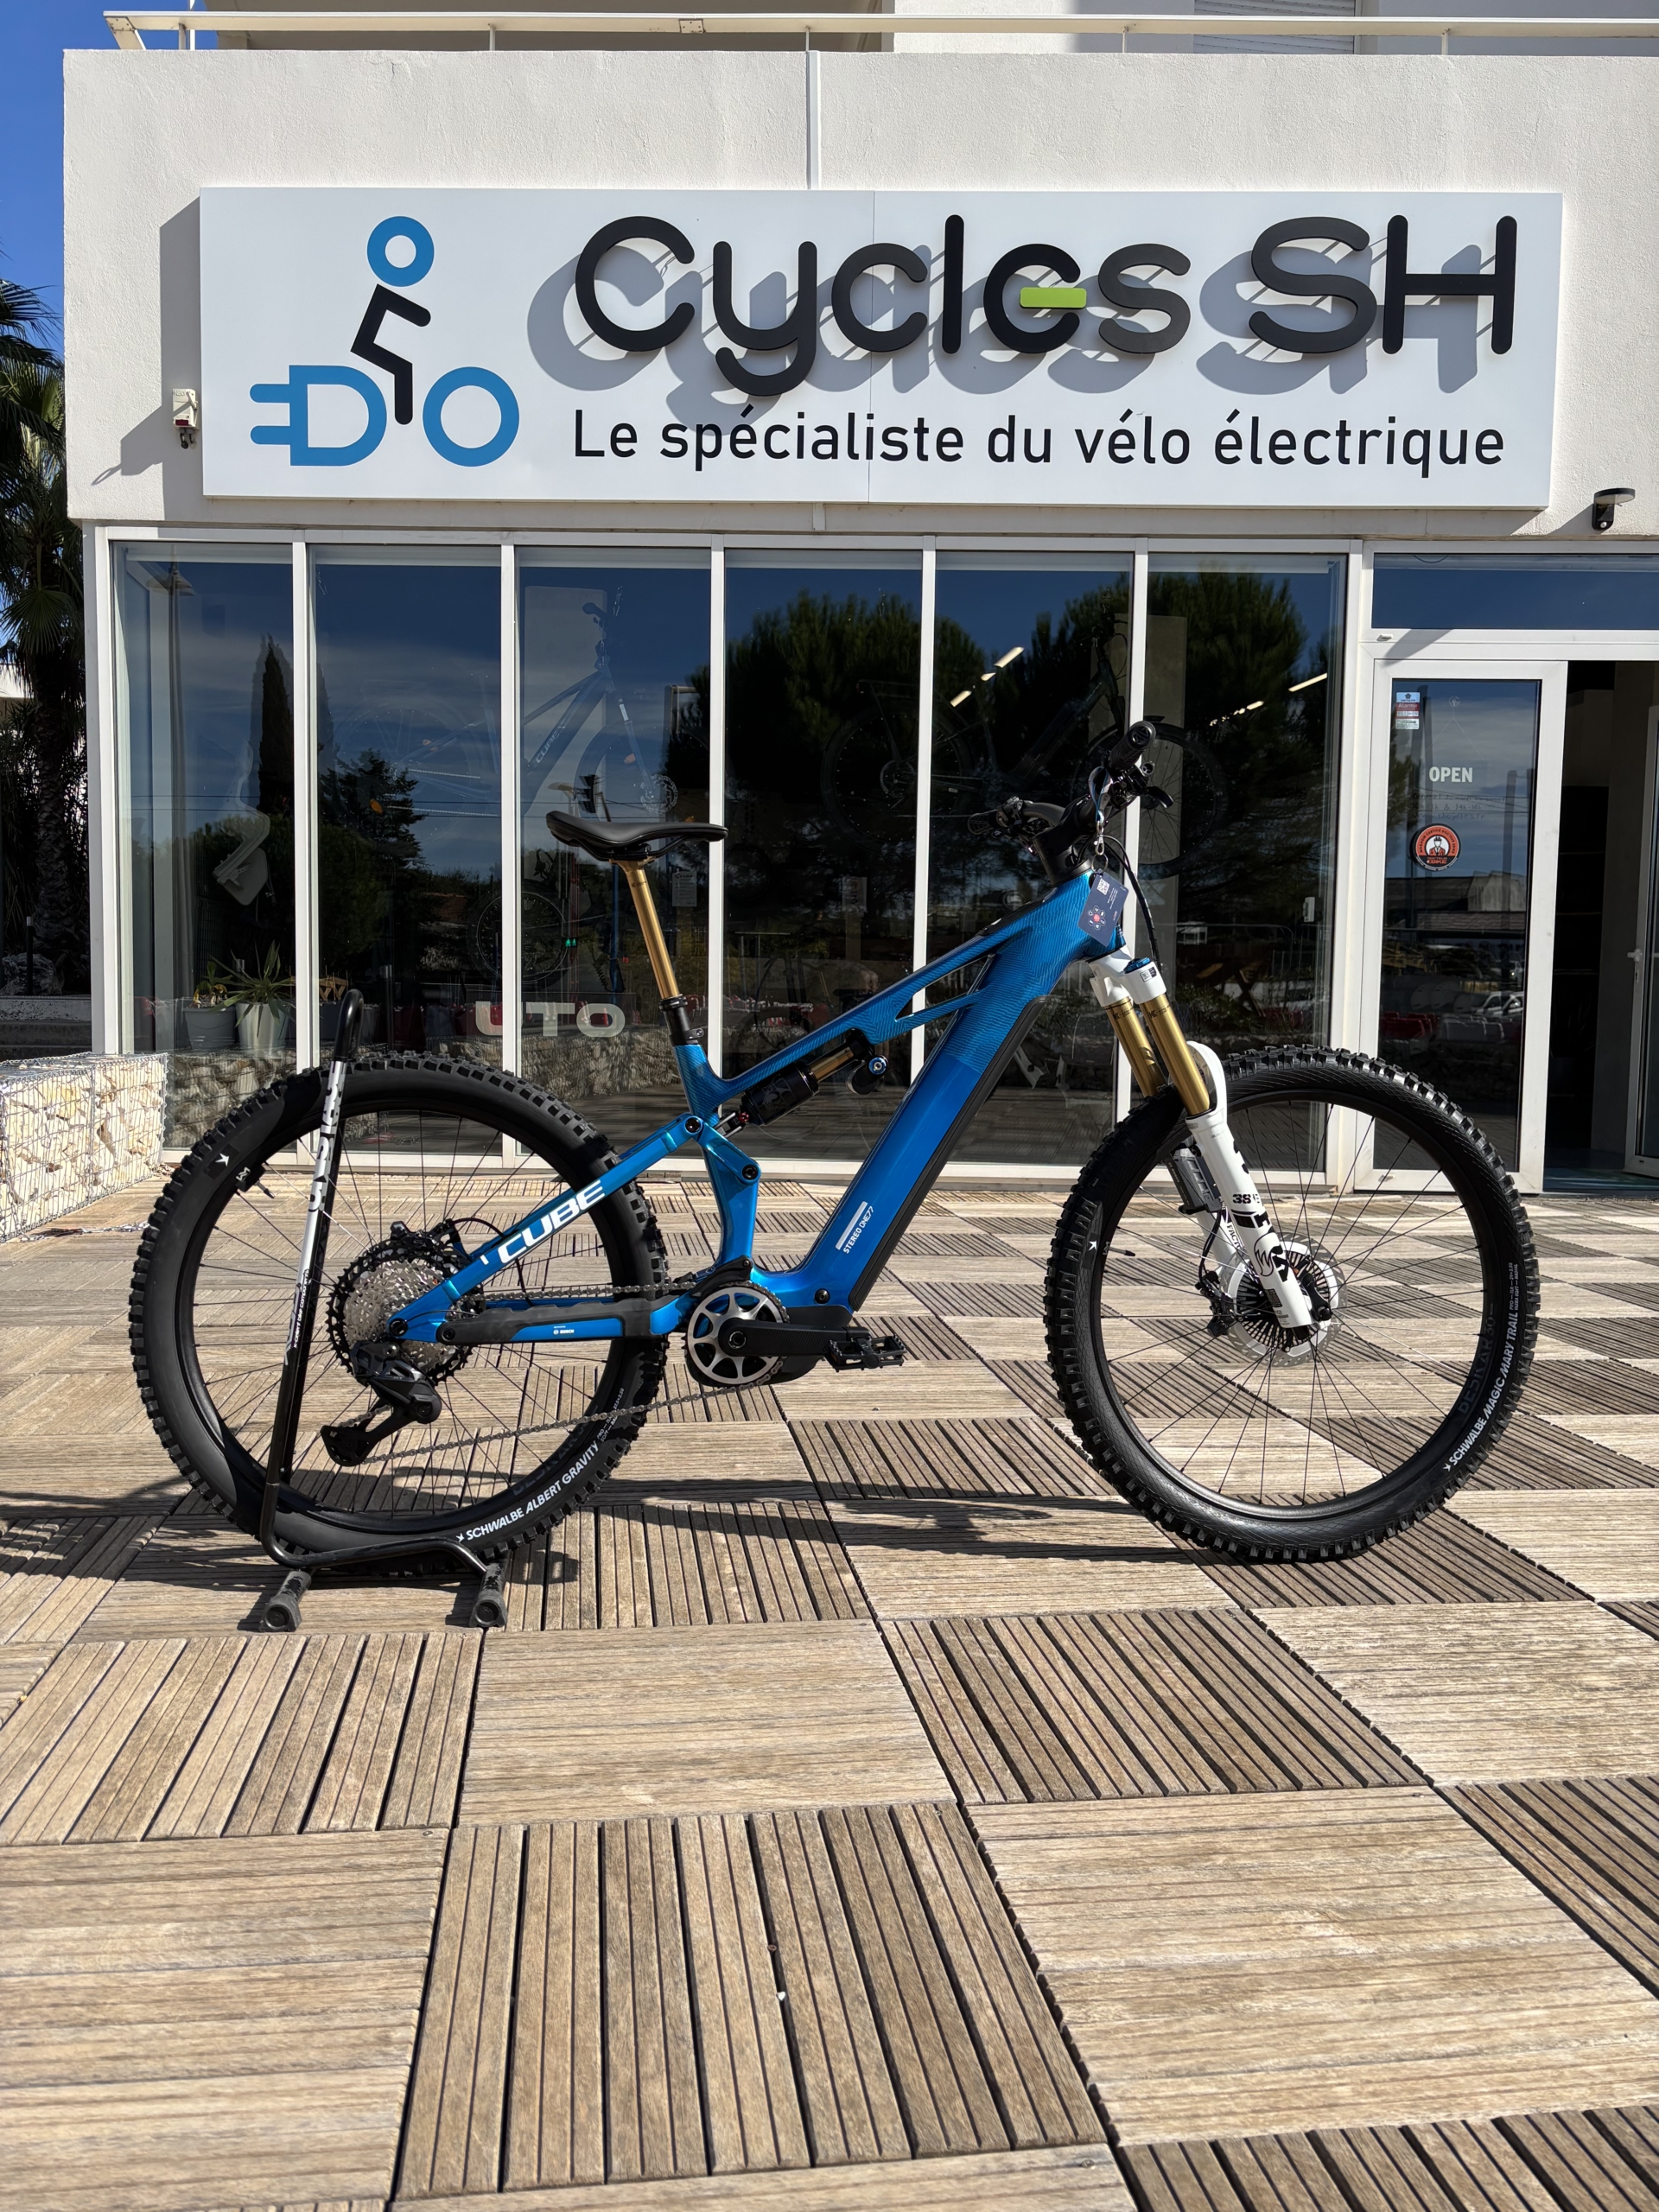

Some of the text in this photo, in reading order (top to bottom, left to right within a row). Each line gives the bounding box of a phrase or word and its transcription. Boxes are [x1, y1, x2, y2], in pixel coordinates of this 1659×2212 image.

[575, 214, 1518, 397] Cycles SH
[575, 404, 1505, 479] Le spécialiste du vélo électrique
[1428, 766, 1473, 783] OPEN
[497, 1179, 606, 1264] CUBE
[842, 1205, 874, 1254] STEREO ONE77
[1448, 1312, 1518, 1466] SCHWALBE MAGIC MARY TRAIL
[466, 1440, 599, 1541] SCHWALBE ALBERT GRAVITY
